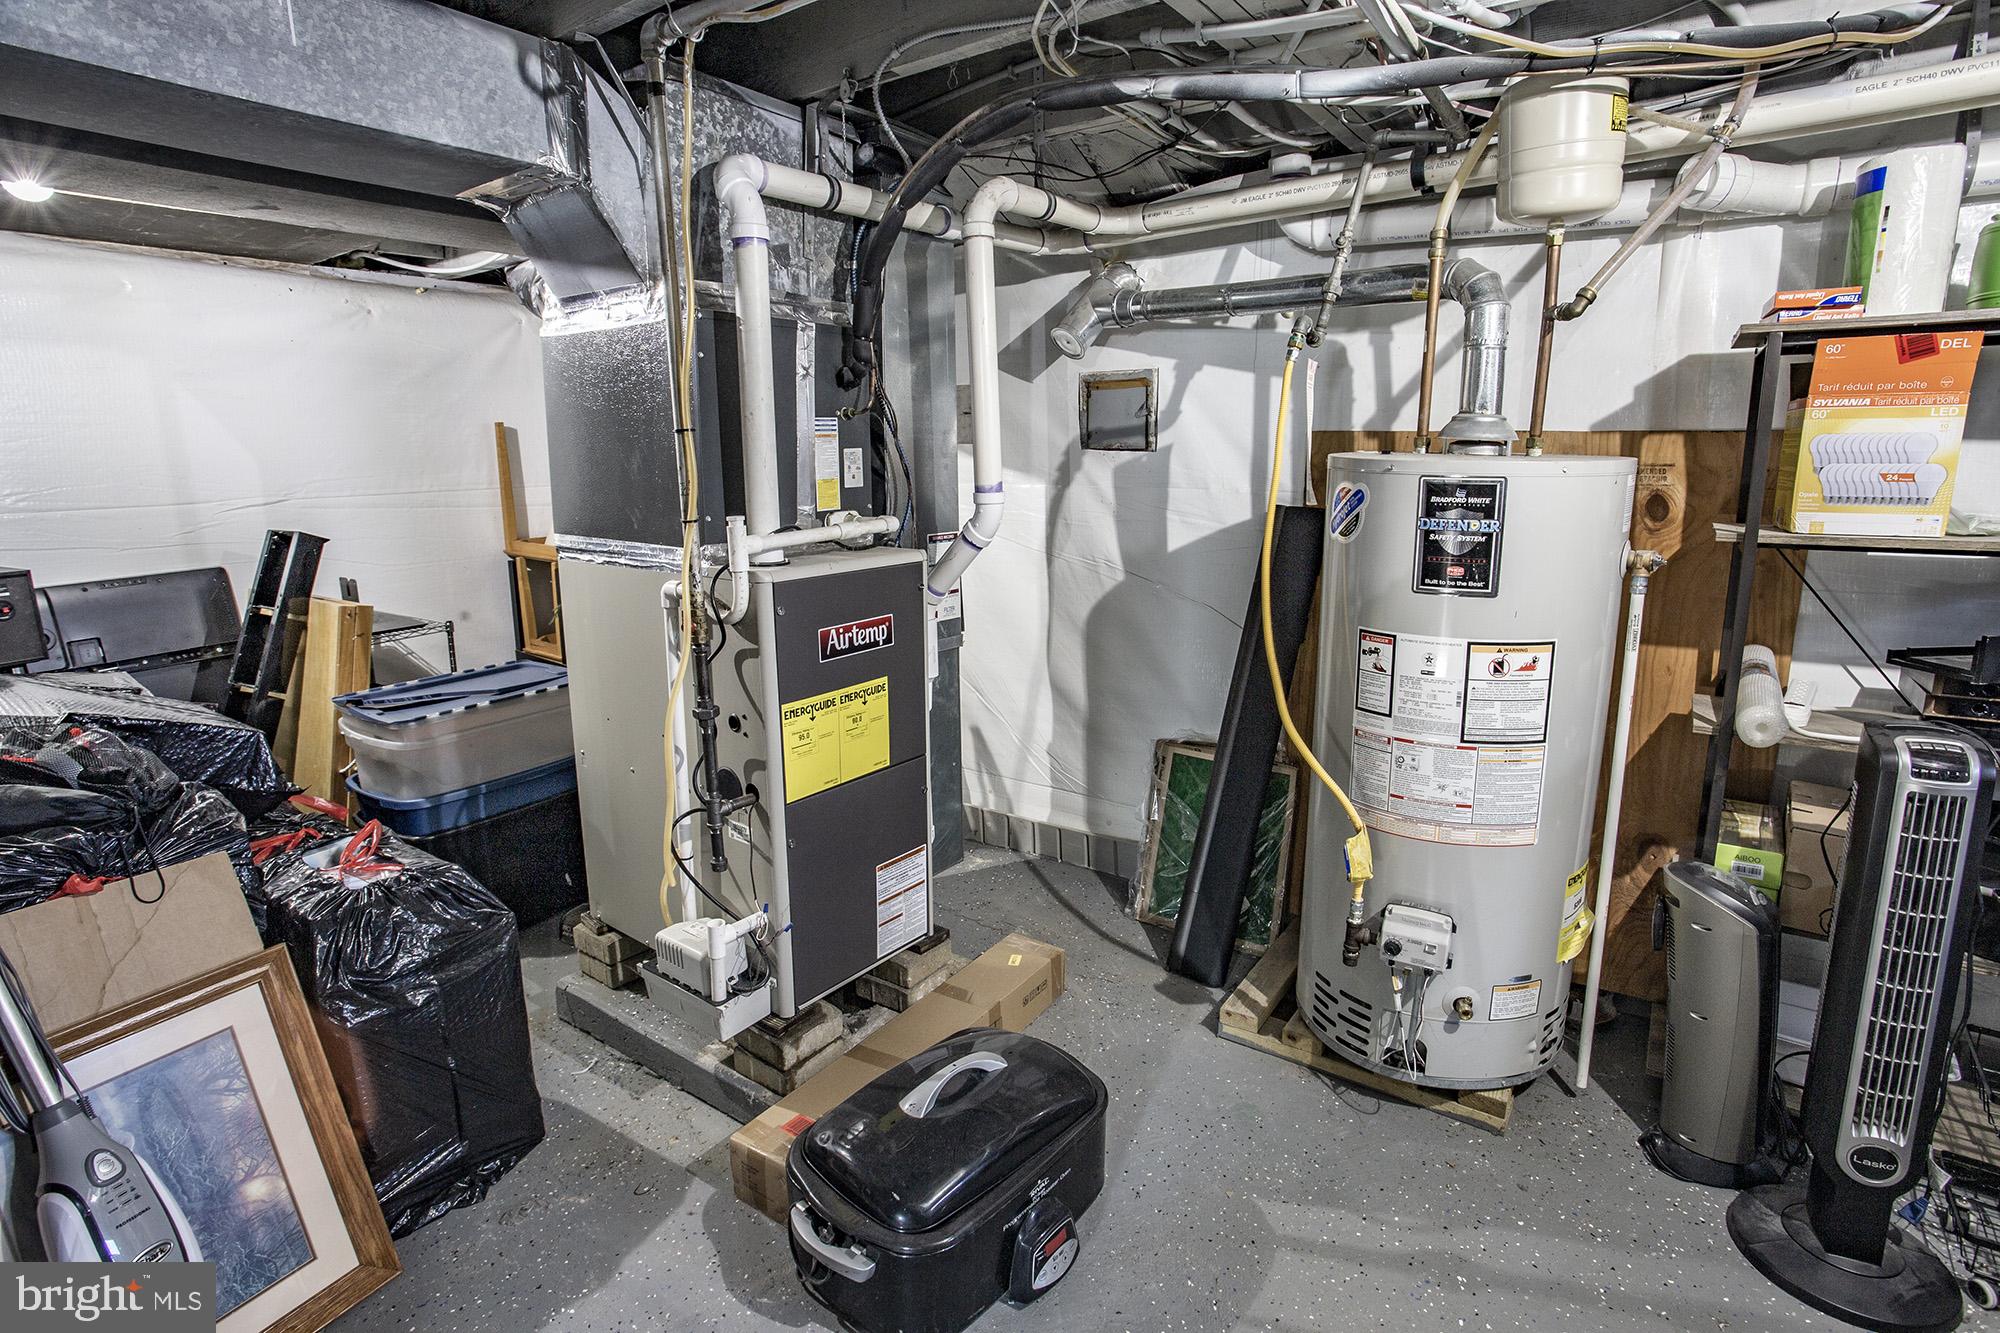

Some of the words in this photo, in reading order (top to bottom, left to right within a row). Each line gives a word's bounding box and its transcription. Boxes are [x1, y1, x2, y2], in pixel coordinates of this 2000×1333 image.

[1856, 81, 1887, 94] EAGLE
[1892, 78, 1902, 87] 2"
[1906, 72, 1937, 84] SCH40
[1940, 67, 1965, 77] DWV
[1248, 194, 1266, 202] EAGLE
[1835, 294, 1859, 303] TERRO
[1940, 338, 1972, 349] DEL
[1818, 383, 1840, 392] Tarif
[1842, 382, 1873, 391] réduit
[1876, 383, 1894, 392] par
[1900, 380, 1928, 389] boîte
[1812, 398, 1870, 407] SYLVANIA
[1874, 398, 1892, 406] Tarif
[1892, 396, 1918, 405] réduit
[1920, 397, 1934, 406] par
[1930, 407, 1959, 416] LED
[1430, 496, 1467, 504] BRADFORD
[1418, 517, 1500, 532] DEFENDER
[1429, 534, 1456, 542] SAFETY
[1456, 534, 1487, 542] SYSTEM
[826, 624, 887, 655] Airtemp
[840, 683, 886, 705] ENERGYGUIDE
[784, 698, 837, 721] ENERGYGUIDE
[798, 732, 810, 742] 95.0
[1735, 854, 1761, 864] AIBOO
[1854, 1155, 1895, 1170] Lasko
[116, 1206, 151, 1229] PROFESSIONAL
